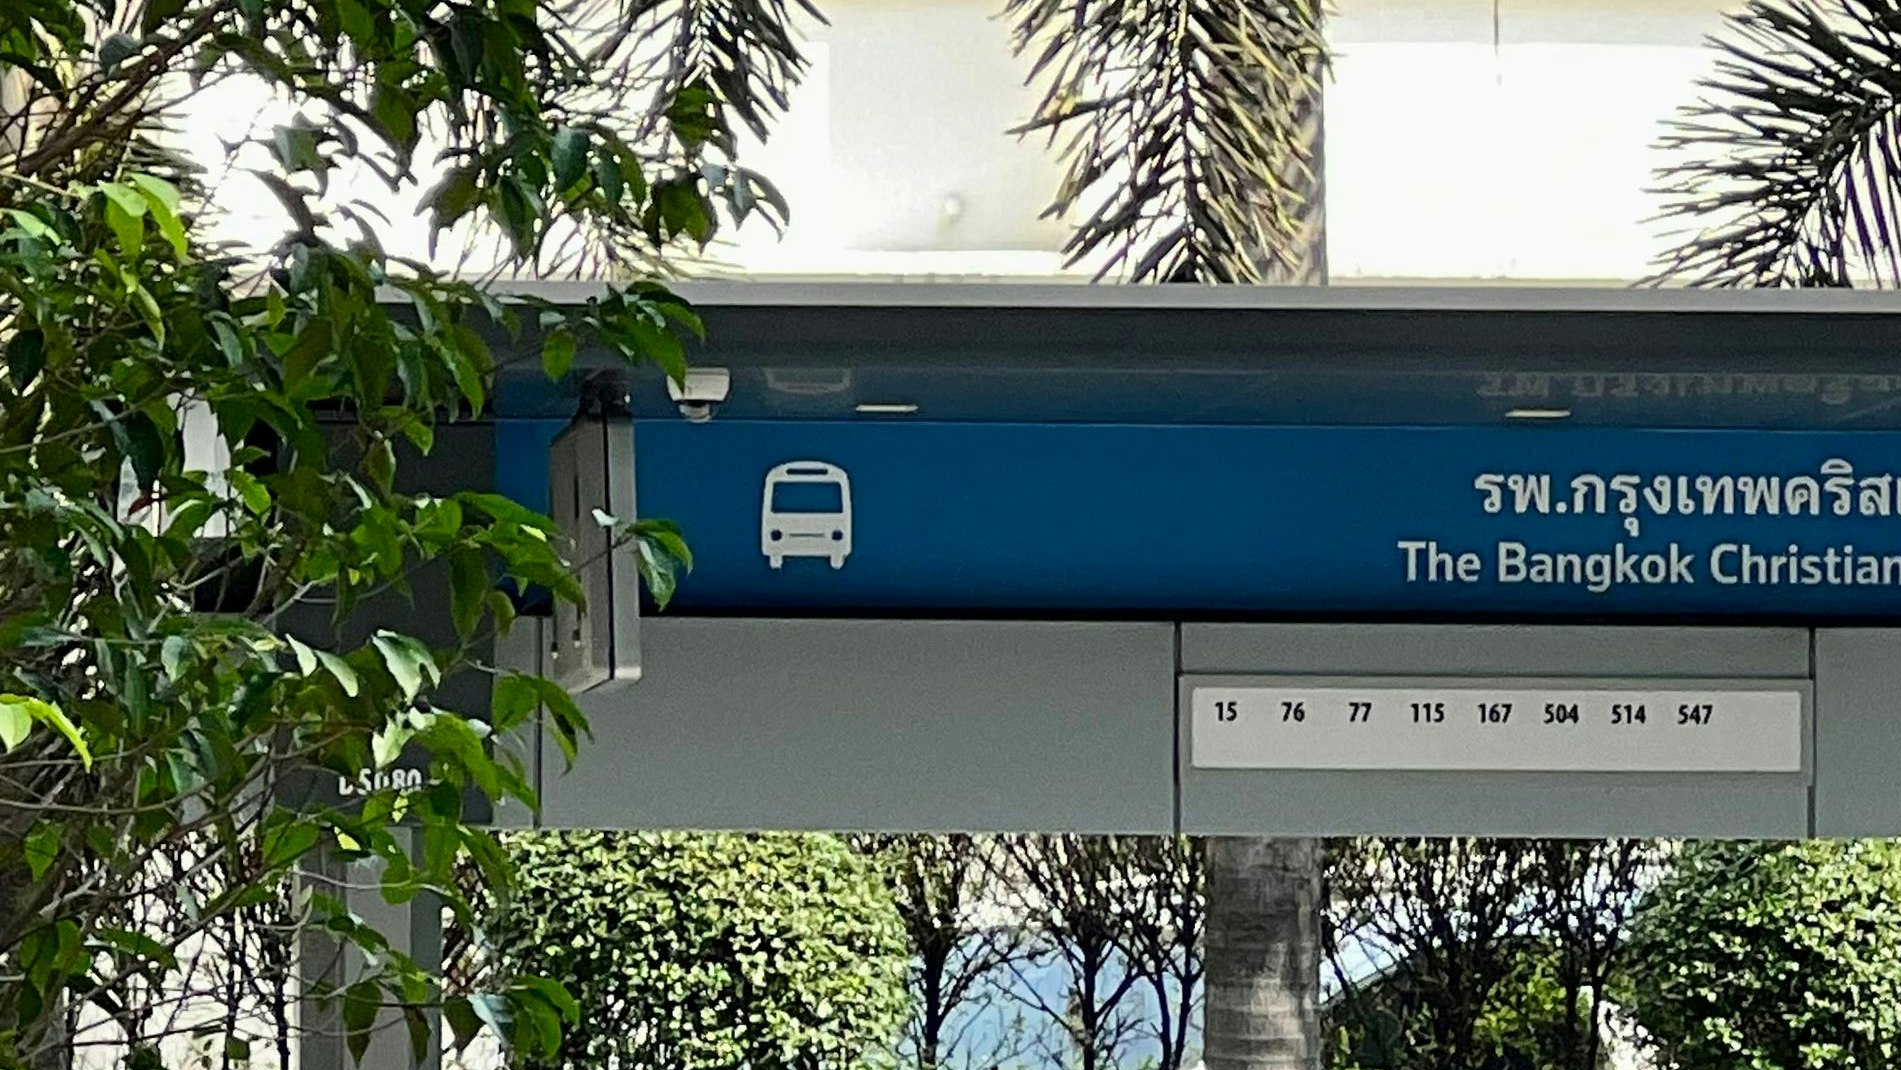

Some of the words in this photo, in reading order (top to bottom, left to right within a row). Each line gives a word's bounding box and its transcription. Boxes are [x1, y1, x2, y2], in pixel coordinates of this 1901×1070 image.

[1397, 541, 1481, 583] The
[1498, 541, 1695, 593] Bangkok
[1213, 701, 1239, 722] 15
[1281, 701, 1306, 723] 76
[1348, 701, 1373, 723] 77
[1410, 702, 1446, 723] 115
[1477, 703, 1513, 724] 167
[1544, 703, 1580, 725] 504
[1611, 704, 1647, 725] 514
[1677, 704, 1713, 725] 547
